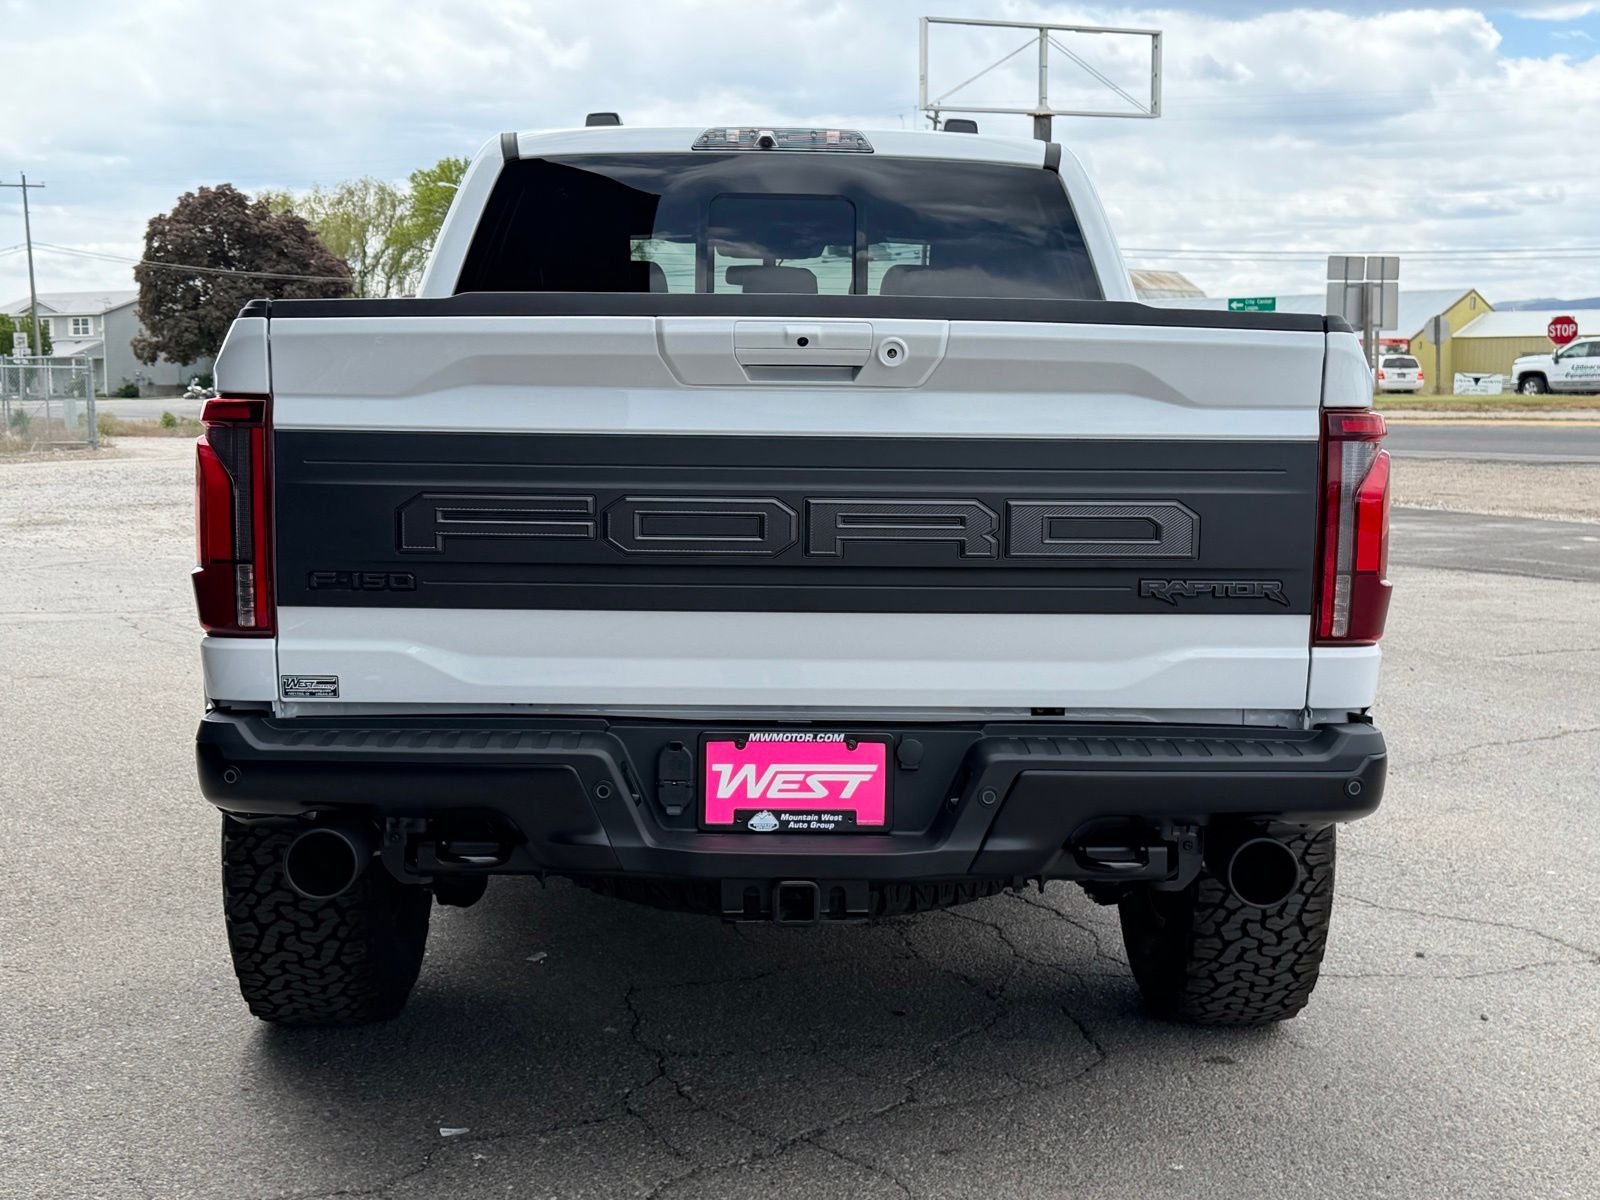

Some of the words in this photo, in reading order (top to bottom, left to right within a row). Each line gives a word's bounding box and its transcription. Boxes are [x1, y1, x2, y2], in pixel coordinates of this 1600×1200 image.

[1549, 324, 1576, 337] STOP
[395, 492, 1200, 560] FORD
[307, 571, 417, 591] F-150
[1138, 579, 1290, 607] RAPTOR
[748, 733, 845, 743] MWMOTOR.COM
[711, 763, 878, 799] WEST
[780, 813, 819, 821] Mountain
[821, 813, 842, 821] West
[788, 821, 808, 829] Auto
[810, 821, 835, 830] Group
